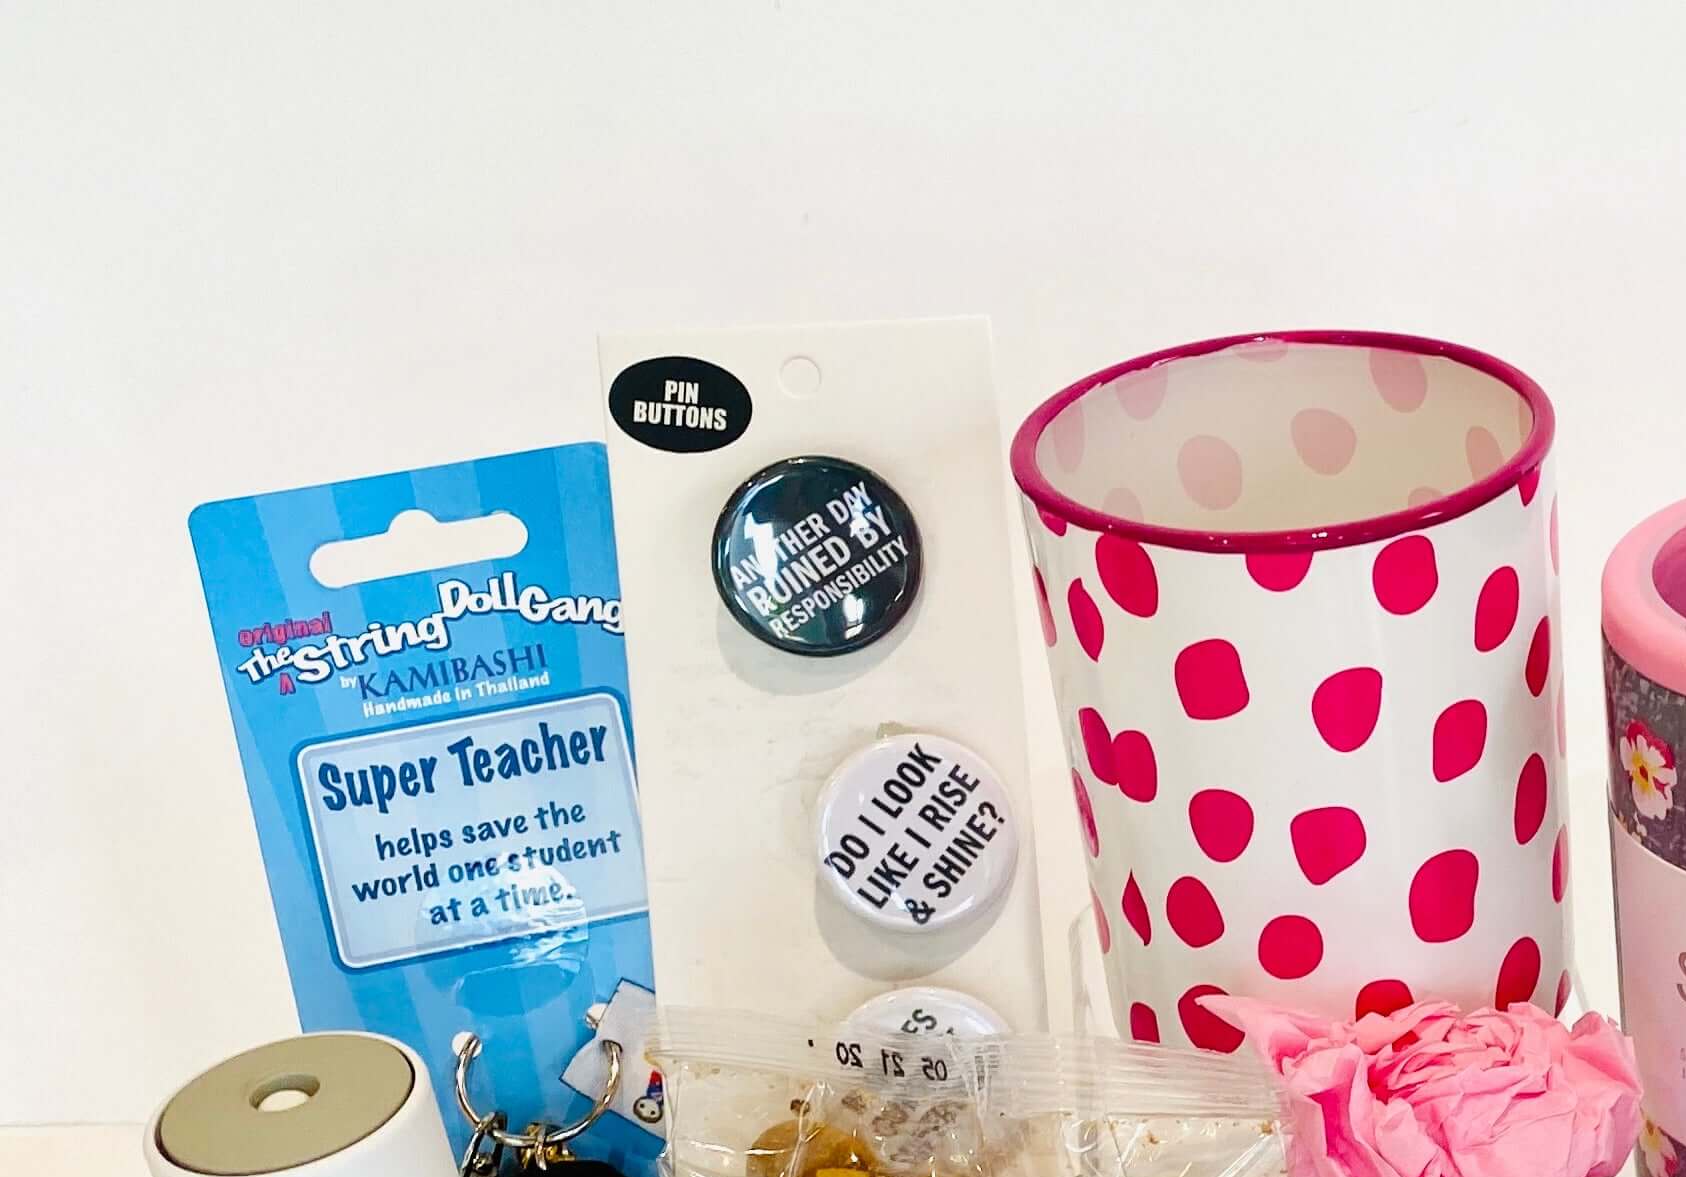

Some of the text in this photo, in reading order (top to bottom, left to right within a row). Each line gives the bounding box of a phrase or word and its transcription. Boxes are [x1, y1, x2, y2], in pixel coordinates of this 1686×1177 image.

[633, 400, 728, 432] BUTTONS
[664, 379, 699, 404] PIN
[730, 480, 873, 590] ANTHER DAY
[747, 505, 892, 617] RUINED BY
[769, 535, 910, 639] RESPONSIBILITY
[237, 610, 333, 648] original
[340, 643, 549, 700] by KAMIBASHI
[362, 691, 452, 718] Handmade
[475, 671, 550, 698] Thailand
[317, 722, 608, 815] Super Teacher
[375, 800, 587, 861] helps save the
[823, 742, 943, 879] DO I LOOK
[856, 764, 981, 910] LIKE I RISE
[352, 829, 622, 902] world one student
[903, 800, 1006, 926] & SHINE?
[429, 880, 577, 926] at a time.
